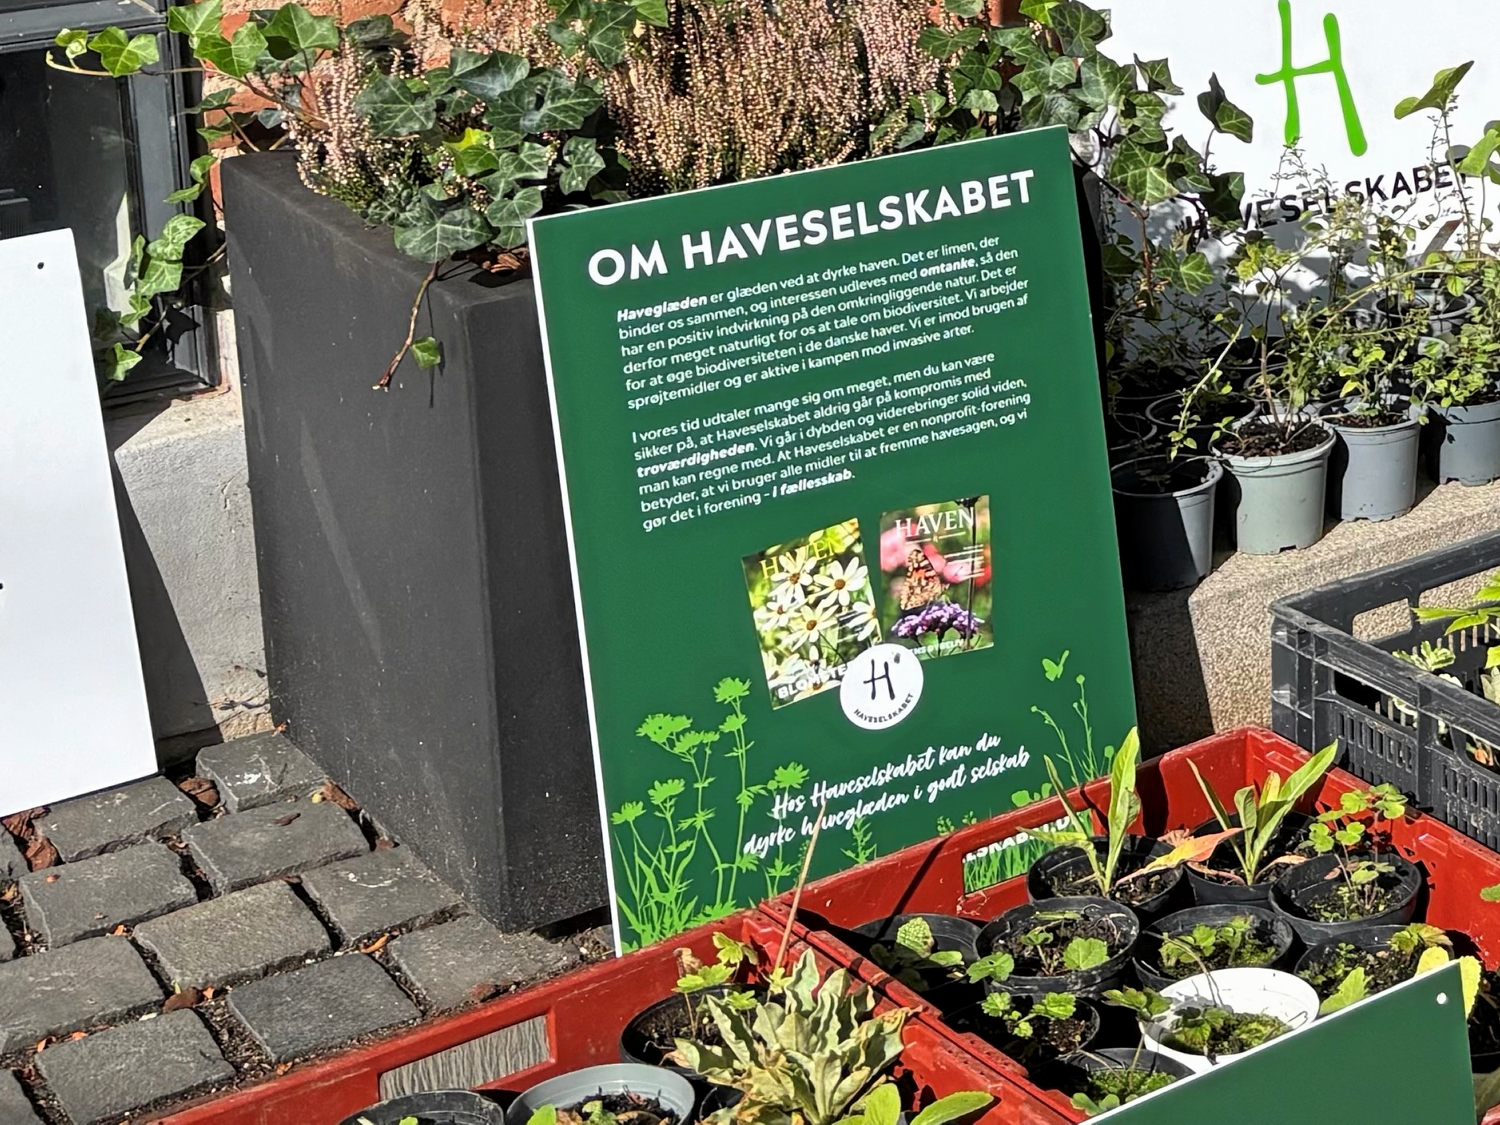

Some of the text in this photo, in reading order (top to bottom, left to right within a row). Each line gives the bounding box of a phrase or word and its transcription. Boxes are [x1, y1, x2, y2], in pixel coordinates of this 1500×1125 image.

[589, 170, 1035, 287] OM HAVESELSKABET
[616, 236, 999, 322] Haveglæden er glæden ved at dyrke haven. Det er limen, der
[618, 249, 1018, 339] binder os sammen, og interessen udleves med omtanke, så den
[621, 265, 1016, 357] har en positiv indvirkning på den omkringliggende natur. Det er
[623, 279, 1028, 374] derfor meget naturligt for os at tale om biodiversitet. Vi arbejder
[625, 378, 646, 391] for
[649, 374, 663, 386] at
[666, 369, 693, 383] øge
[695, 346, 796, 376] biodiversiteten
[804, 340, 822, 352] de
[824, 330, 868, 348] danske
[870, 323, 907, 338] haver.
[908, 316, 921, 329] Vi
[923, 316, 936, 326] er
[938, 306, 970, 323] imod
[971, 299, 1015, 315] brugen
[1016, 292, 1027, 306] af
[627, 380, 720, 410] sprøjtemidler
[723, 375, 741, 388] og
[743, 372, 758, 383] er
[760, 363, 799, 379] aktive
[807, 350, 859, 368] kampen
[861, 340, 890, 357] mod
[892, 331, 941, 350] invasive
[942, 324, 974, 339] arter.
[634, 367, 991, 460] sikker på, at Haveselskabet aldrig går på kompromis med
[636, 442, 757, 478] troværdigheden.
[758, 434, 773, 448] Vi
[775, 430, 797, 448] går
[805, 418, 855, 438] dybden
[857, 414, 874, 426] og
[876, 393, 959, 420] viderebringer
[961, 383, 990, 406] solid
[991, 378, 1027, 396] viden,
[639, 425, 678, 441] vores
[680, 417, 700, 432] tid
[702, 408, 751, 427] udtaler
[754, 397, 799, 415] mange
[801, 391, 821, 405] sig
[822, 387, 844, 399] om
[846, 376, 891, 394] meget,
[893, 369, 921, 383] men
[922, 364, 939, 376] du
[941, 360, 962, 372] kan
[963, 352, 994, 367] være
[895, 507, 975, 538] HAVEN
[863, 658, 896, 701] H
[743, 824, 796, 859] dyrke
[927, 764, 967, 804] godt
[970, 745, 1030, 781] selskab
[773, 732, 1001, 819] Hos Haveselskabet kan du
